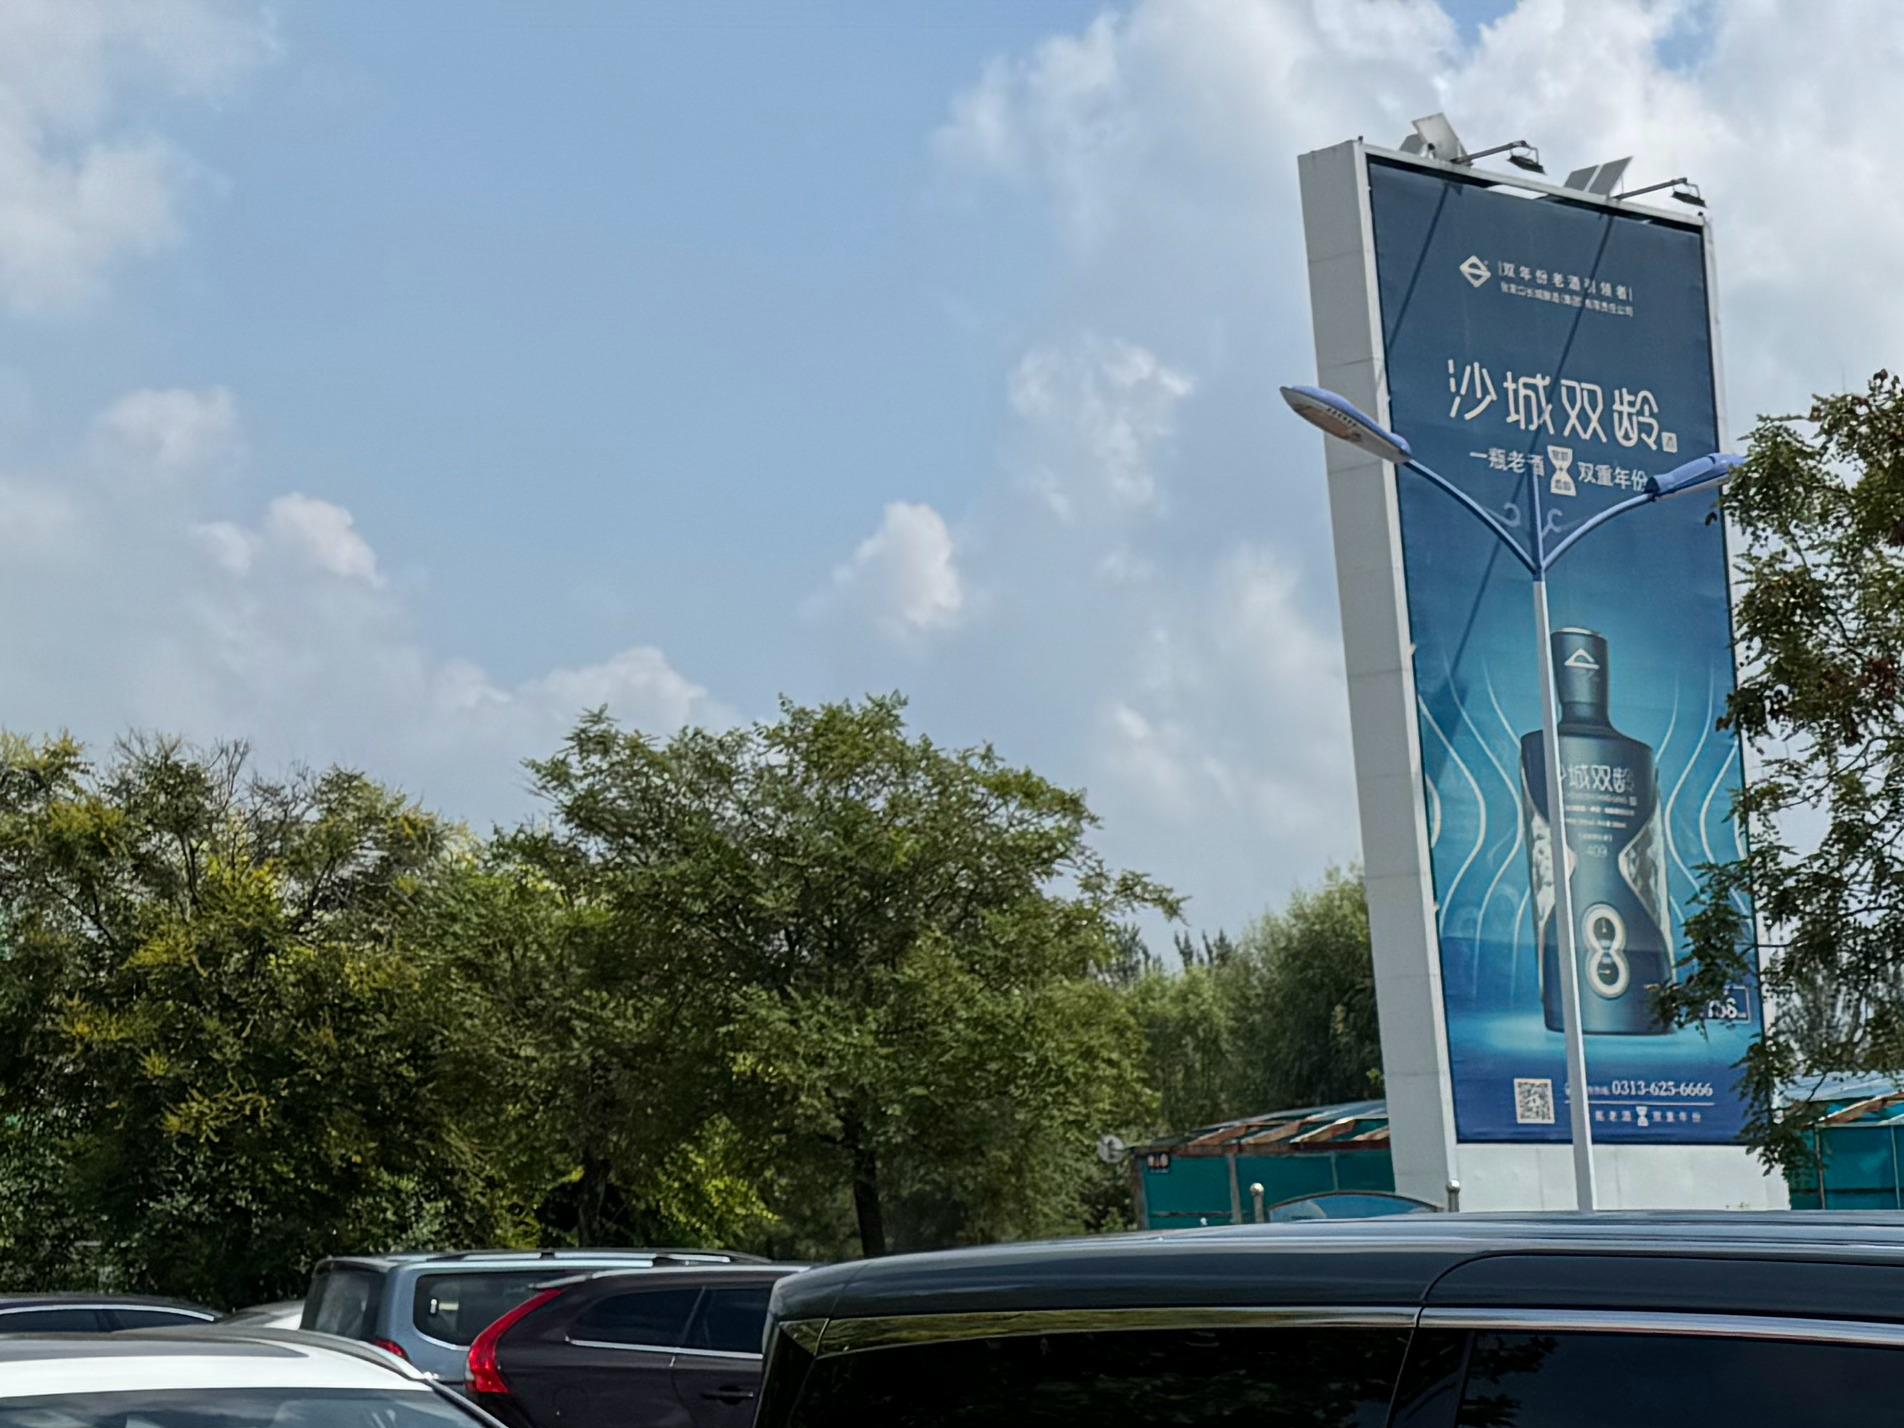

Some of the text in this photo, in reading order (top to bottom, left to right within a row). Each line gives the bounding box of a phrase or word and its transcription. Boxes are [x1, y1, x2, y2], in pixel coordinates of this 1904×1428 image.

[1448, 359, 1659, 451] 沙城双龄
[1577, 461, 1649, 492] 双重年份
[1560, 764, 1634, 793] 城双龄
[1612, 1080, 1713, 1097] 0313-625-6666
